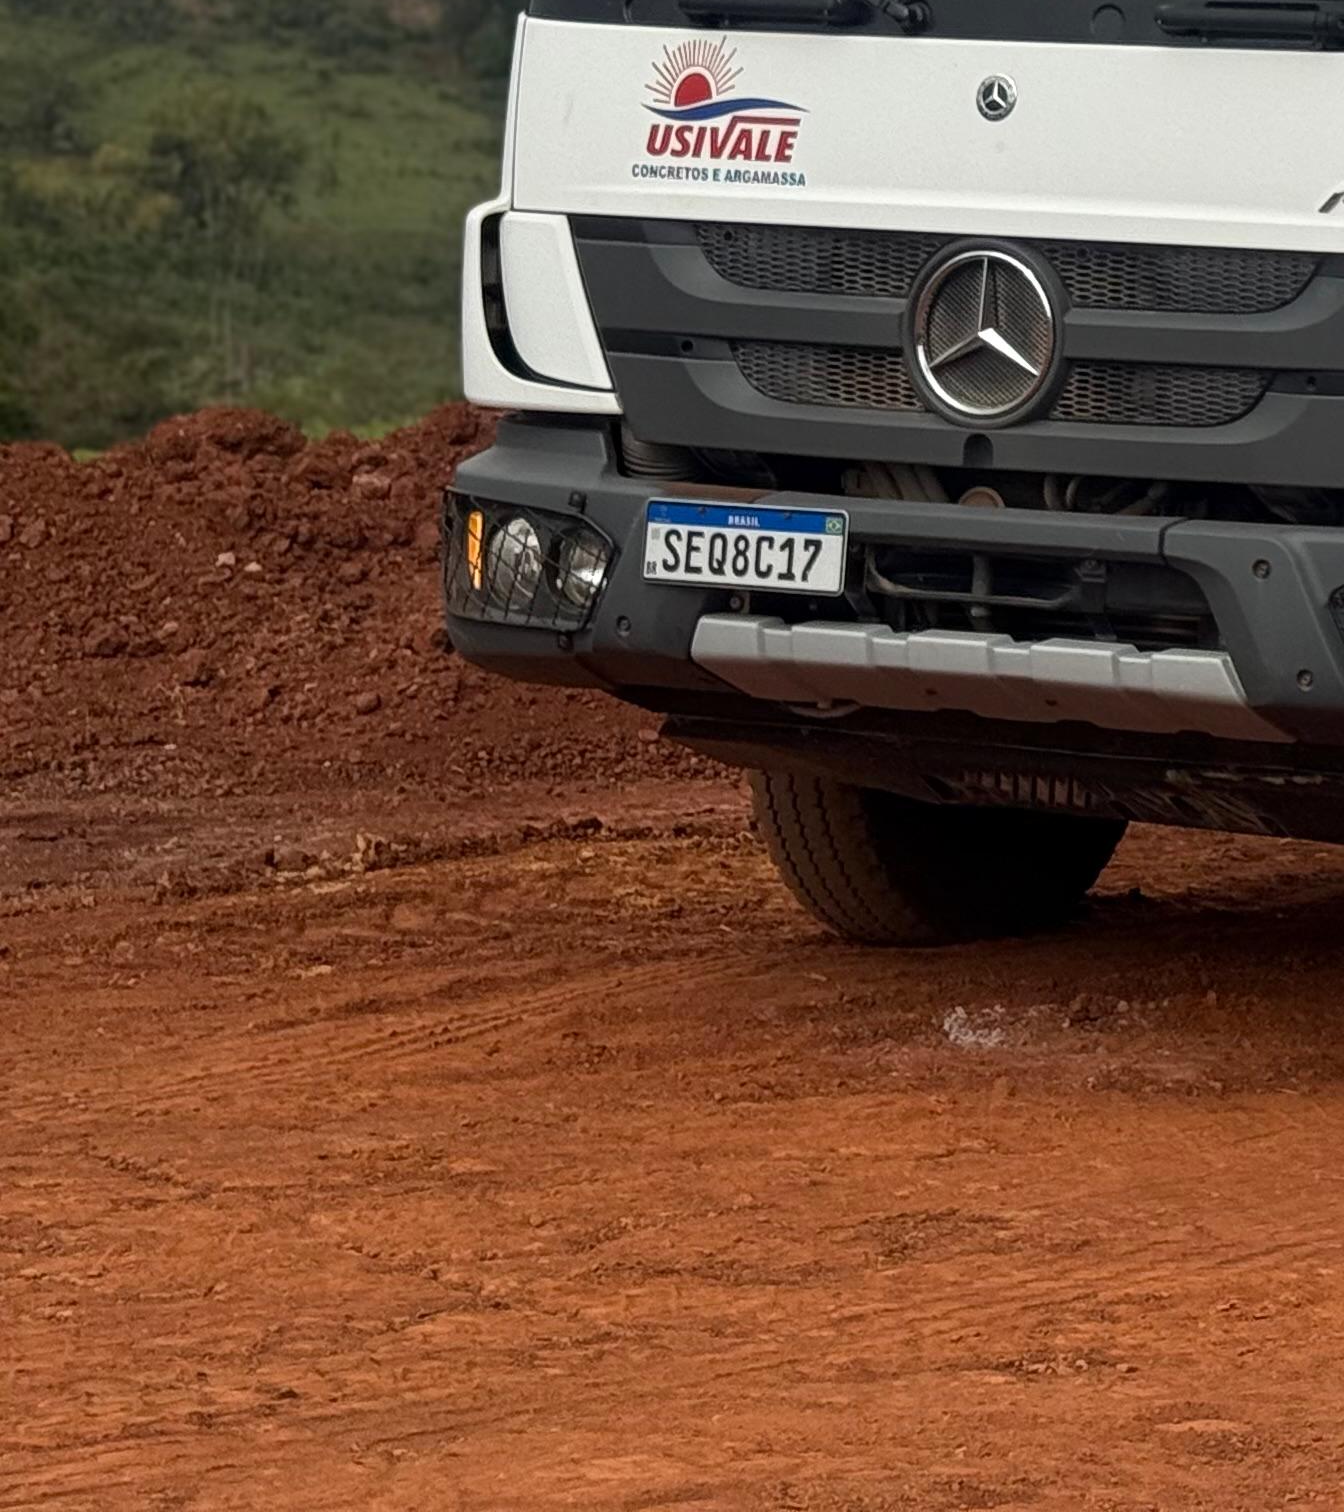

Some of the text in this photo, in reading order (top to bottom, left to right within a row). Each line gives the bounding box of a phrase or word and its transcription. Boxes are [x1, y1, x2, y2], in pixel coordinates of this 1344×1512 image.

[645, 115, 802, 164] USIVALE
[631, 163, 807, 187] CONCRETOS E ARGAMASSA
[727, 514, 761, 528] BRASIL
[662, 528, 823, 583] SEQ8C17
